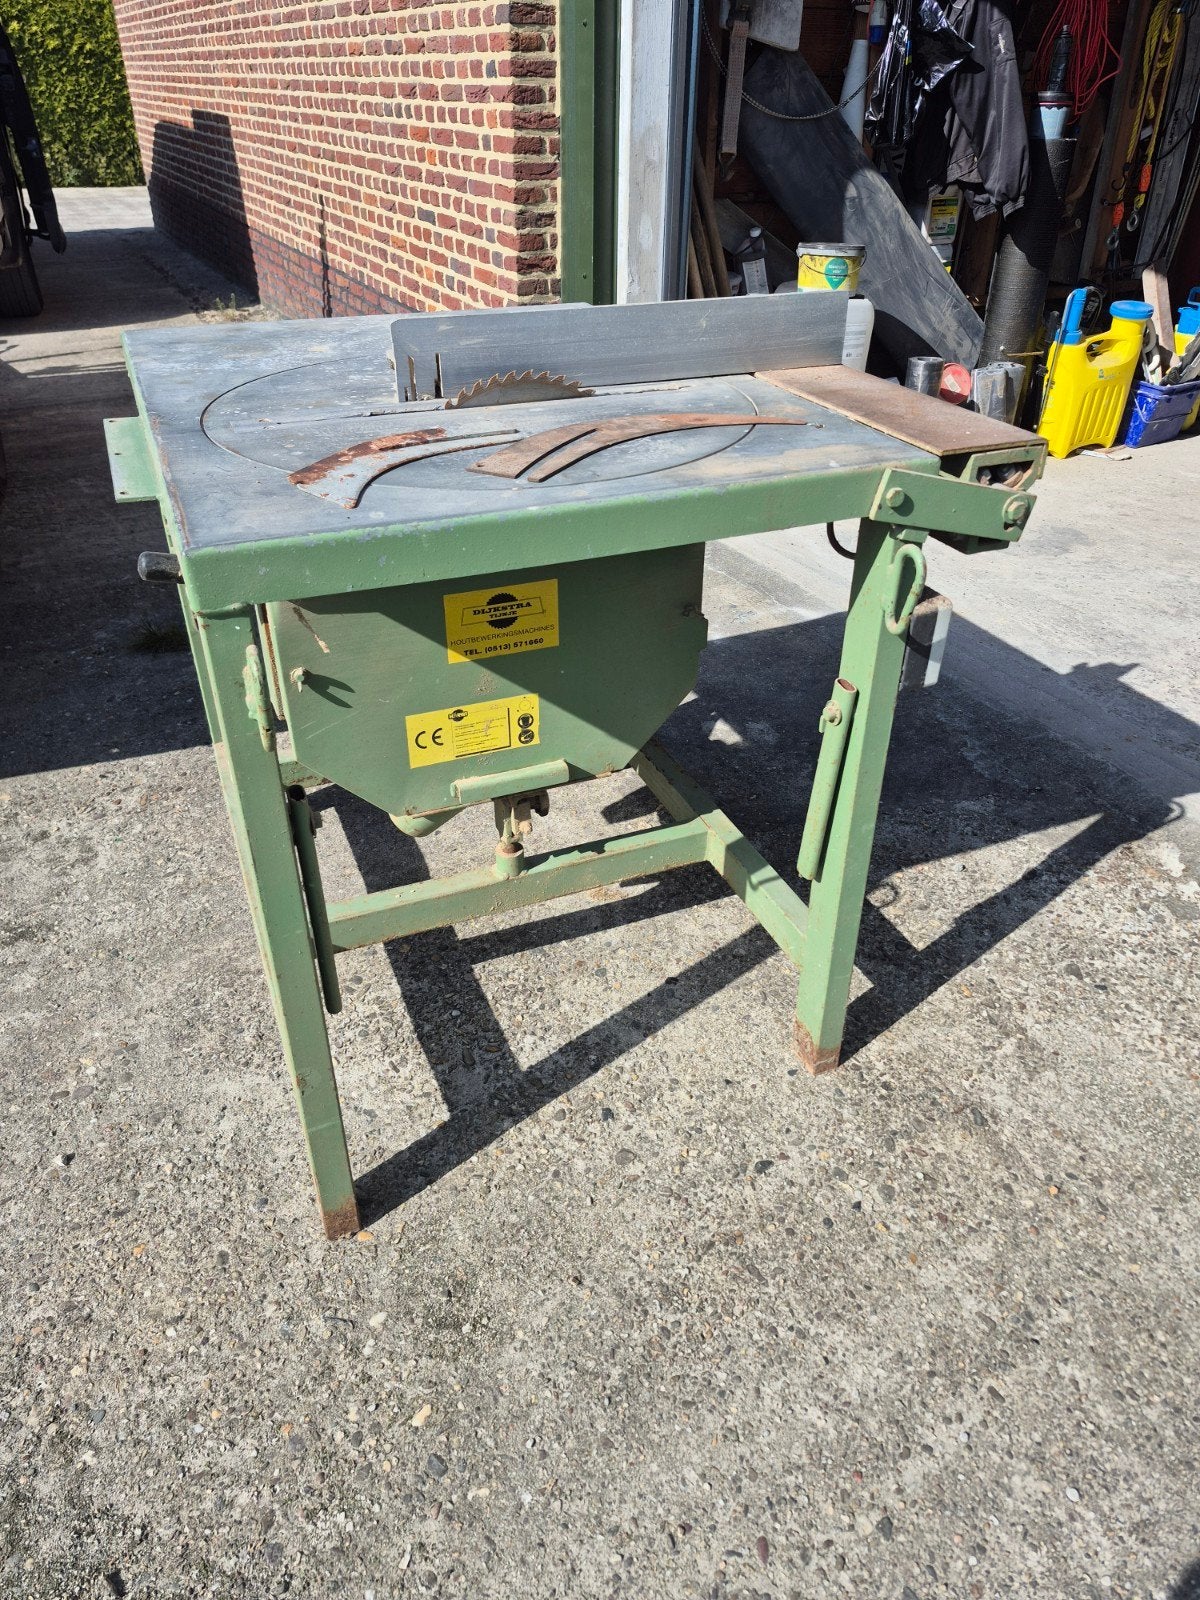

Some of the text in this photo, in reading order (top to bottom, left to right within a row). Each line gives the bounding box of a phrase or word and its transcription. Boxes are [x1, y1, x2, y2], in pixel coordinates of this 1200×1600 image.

[472, 602, 533, 615] DIJKSTRA
[489, 610, 518, 619] TIJNJE
[450, 623, 555, 646] HOUTBEWERKINGSMACHINES
[485, 643, 511, 654] (0513)
[513, 637, 544, 648] 571660
[415, 727, 444, 749] CE
